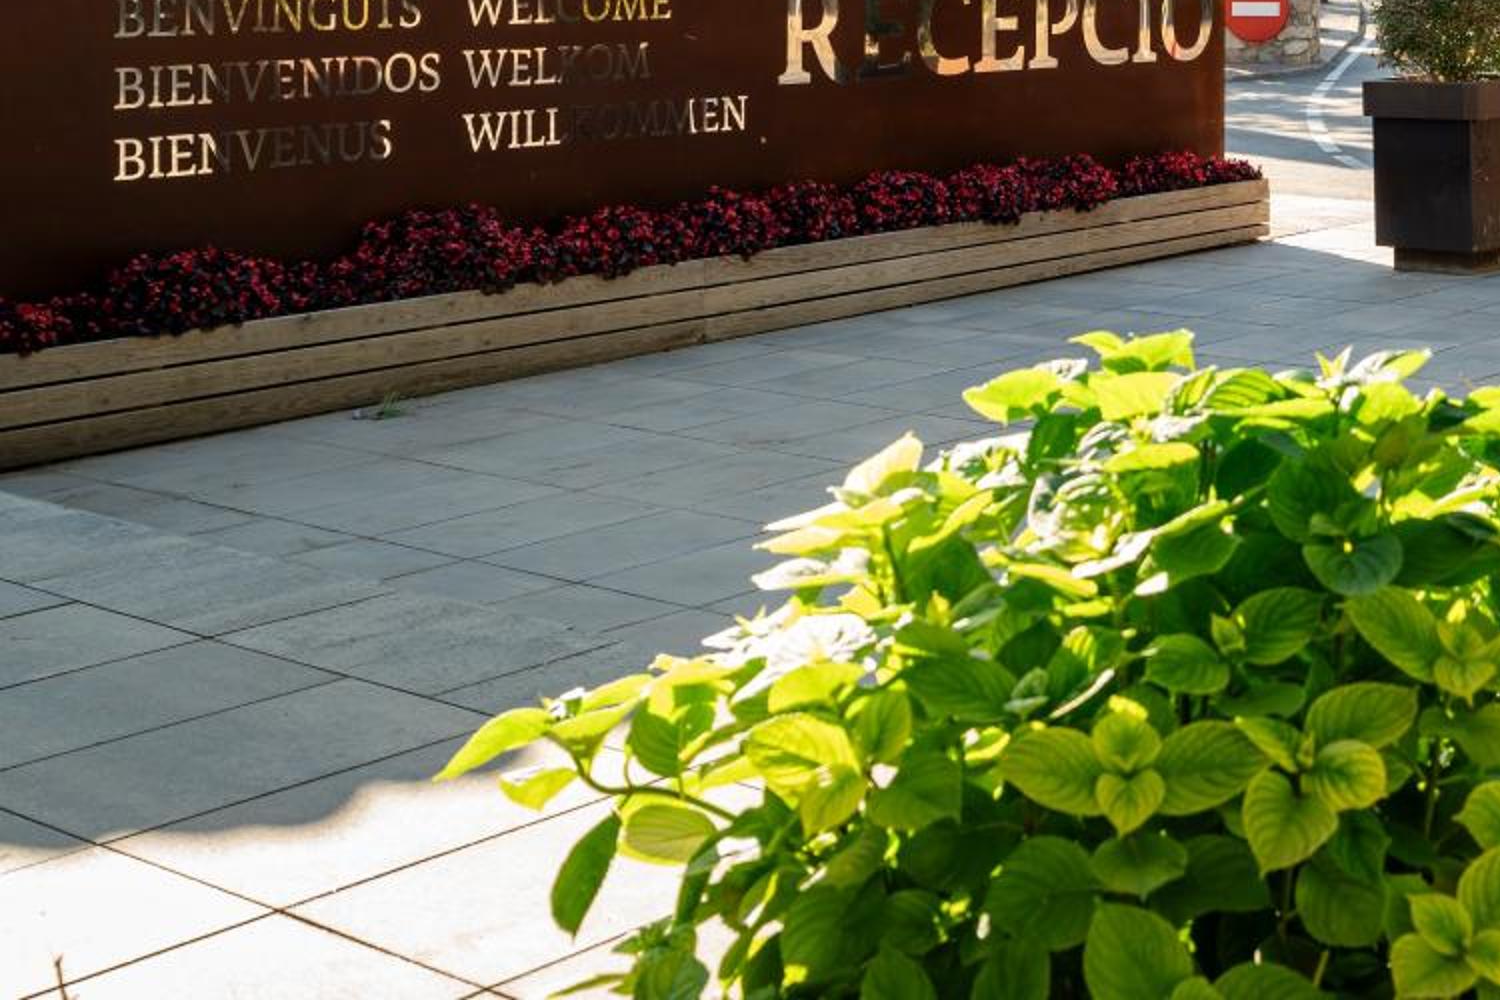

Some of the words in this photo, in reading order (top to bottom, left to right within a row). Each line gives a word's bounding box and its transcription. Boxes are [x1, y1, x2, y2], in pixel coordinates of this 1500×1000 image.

[113, 51, 442, 110] BIENVENIDOS
[463, 41, 653, 89] WELKOM
[113, 119, 393, 181] BIENVENUS
